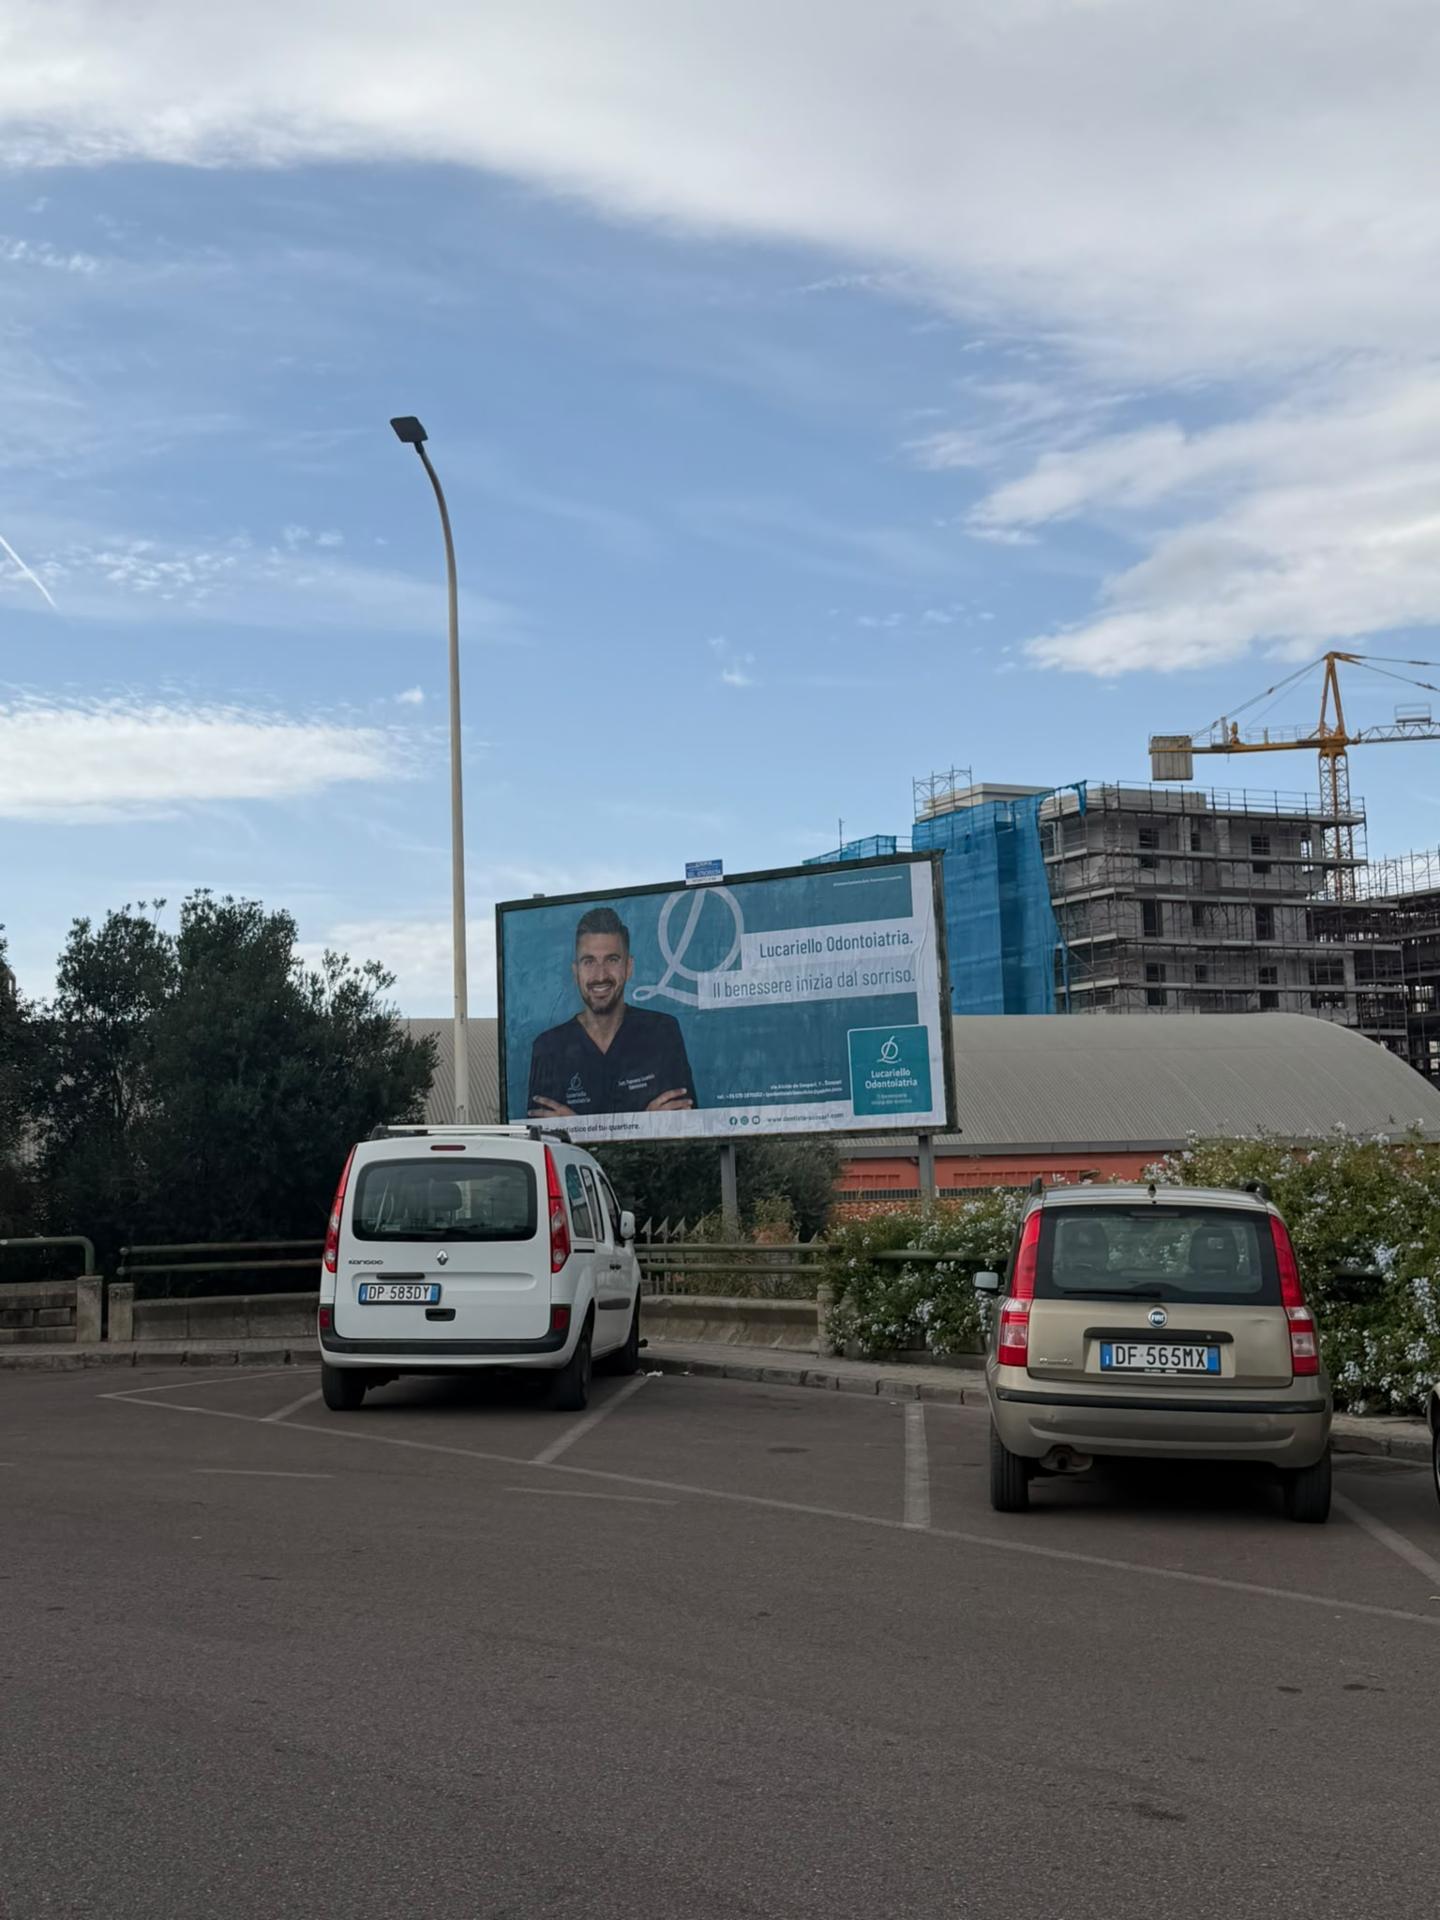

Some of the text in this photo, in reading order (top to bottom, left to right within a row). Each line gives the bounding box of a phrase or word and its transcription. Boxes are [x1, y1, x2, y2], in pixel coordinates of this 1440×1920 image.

[760, 930, 913, 958] Lucariello Odontoiatria.
[713, 967, 916, 998] Il benessere inizia dal sorriso.
[870, 1067, 911, 1079] Lucariello
[864, 1077, 918, 1089] Odontoiatria
[368, 1286, 385, 1300] DP
[389, 1286, 430, 1300] 583DY
[1115, 1345, 1138, 1365] DF
[1145, 1346, 1206, 1368] 565MX
